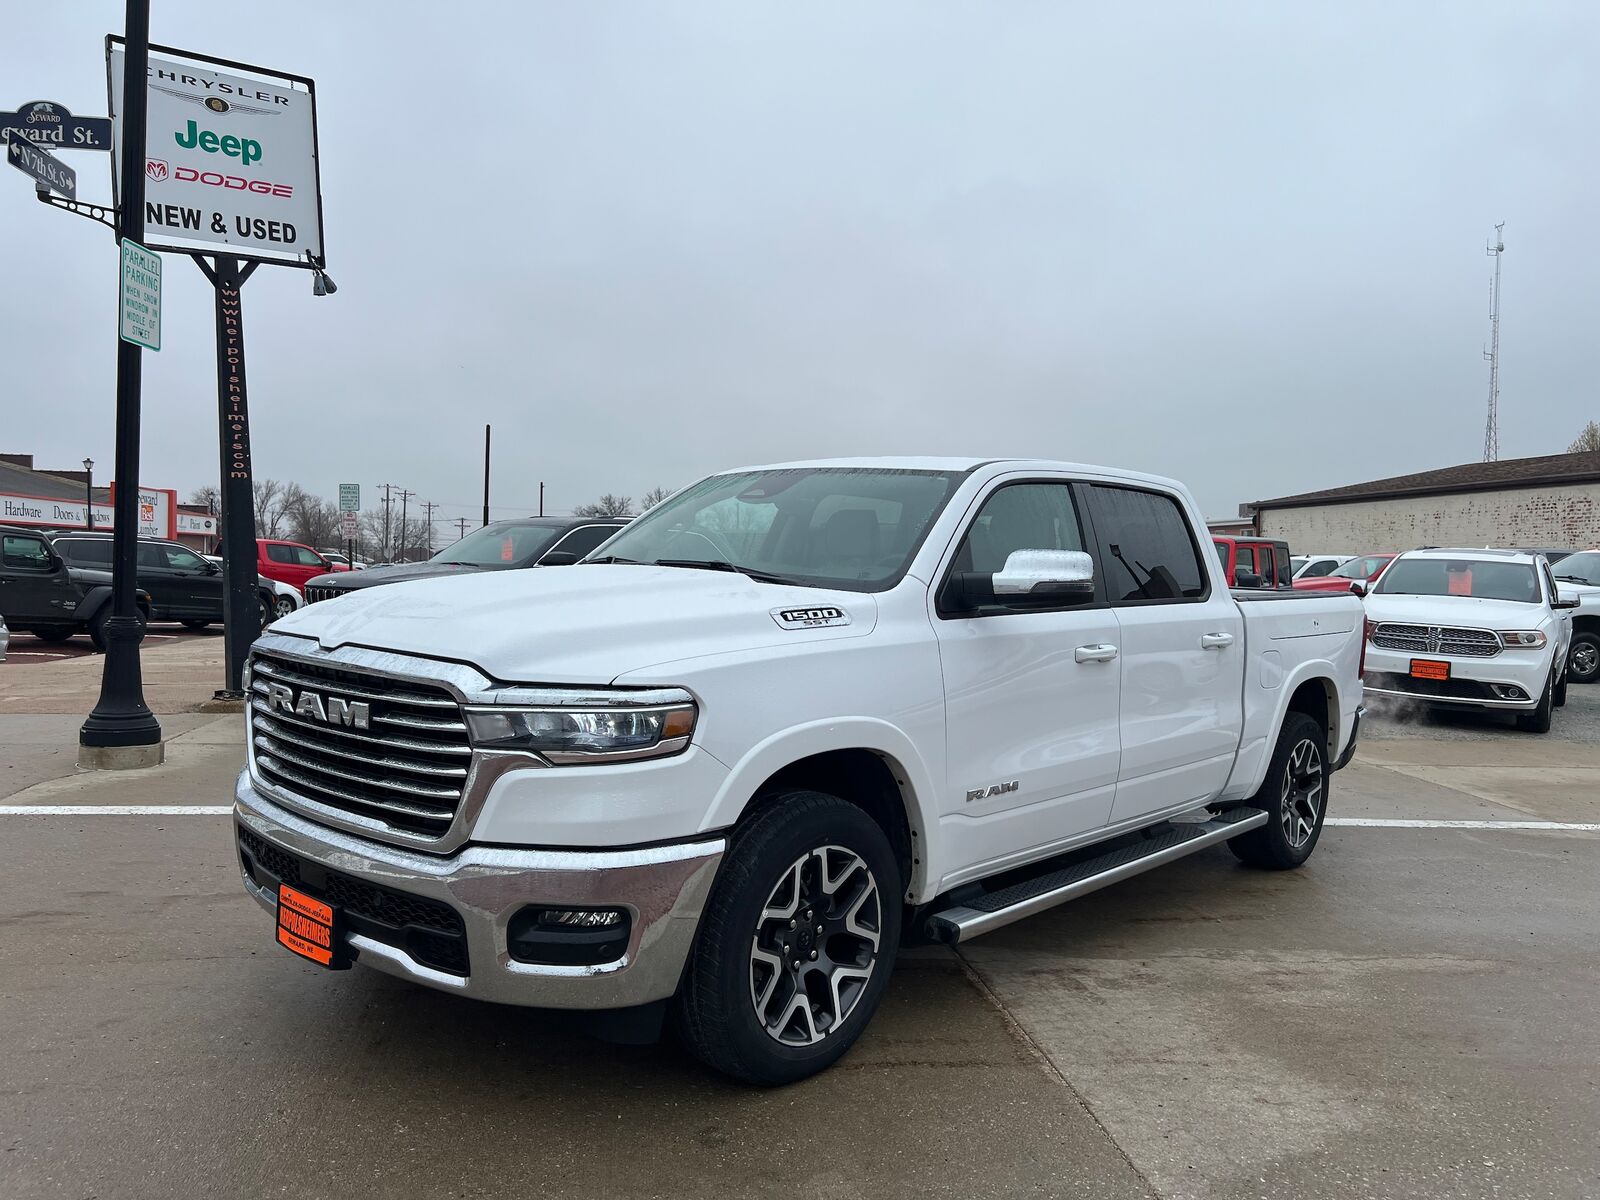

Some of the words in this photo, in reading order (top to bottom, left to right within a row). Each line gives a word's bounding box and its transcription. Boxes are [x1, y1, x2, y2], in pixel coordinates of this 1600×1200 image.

[73, 126, 100, 145] St.
[175, 120, 262, 166] Jeep
[21, 145, 31, 167] N
[32, 152, 47, 177] 7th
[60, 170, 66, 188] S
[175, 167, 293, 198] DODGE
[146, 202, 201, 230] NEW
[210, 212, 227, 234] &
[236, 216, 297, 244] USED
[125, 247, 160, 277] PARALLEL
[126, 265, 158, 292] PARKING
[126, 285, 140, 299] WHEN
[143, 292, 158, 306] SNOW
[126, 310, 146, 326] MIDDLE
[148, 319, 156, 329] OF
[152, 308, 158, 318] IN
[132, 325, 151, 340] STREET
[4, 500, 42, 518] Hardware
[53, 505, 74, 520] Doors
[82, 508, 110, 523] Wndows
[783, 609, 838, 621] 1500
[268, 682, 370, 730] RAM
[966, 780, 1019, 802] RAM
